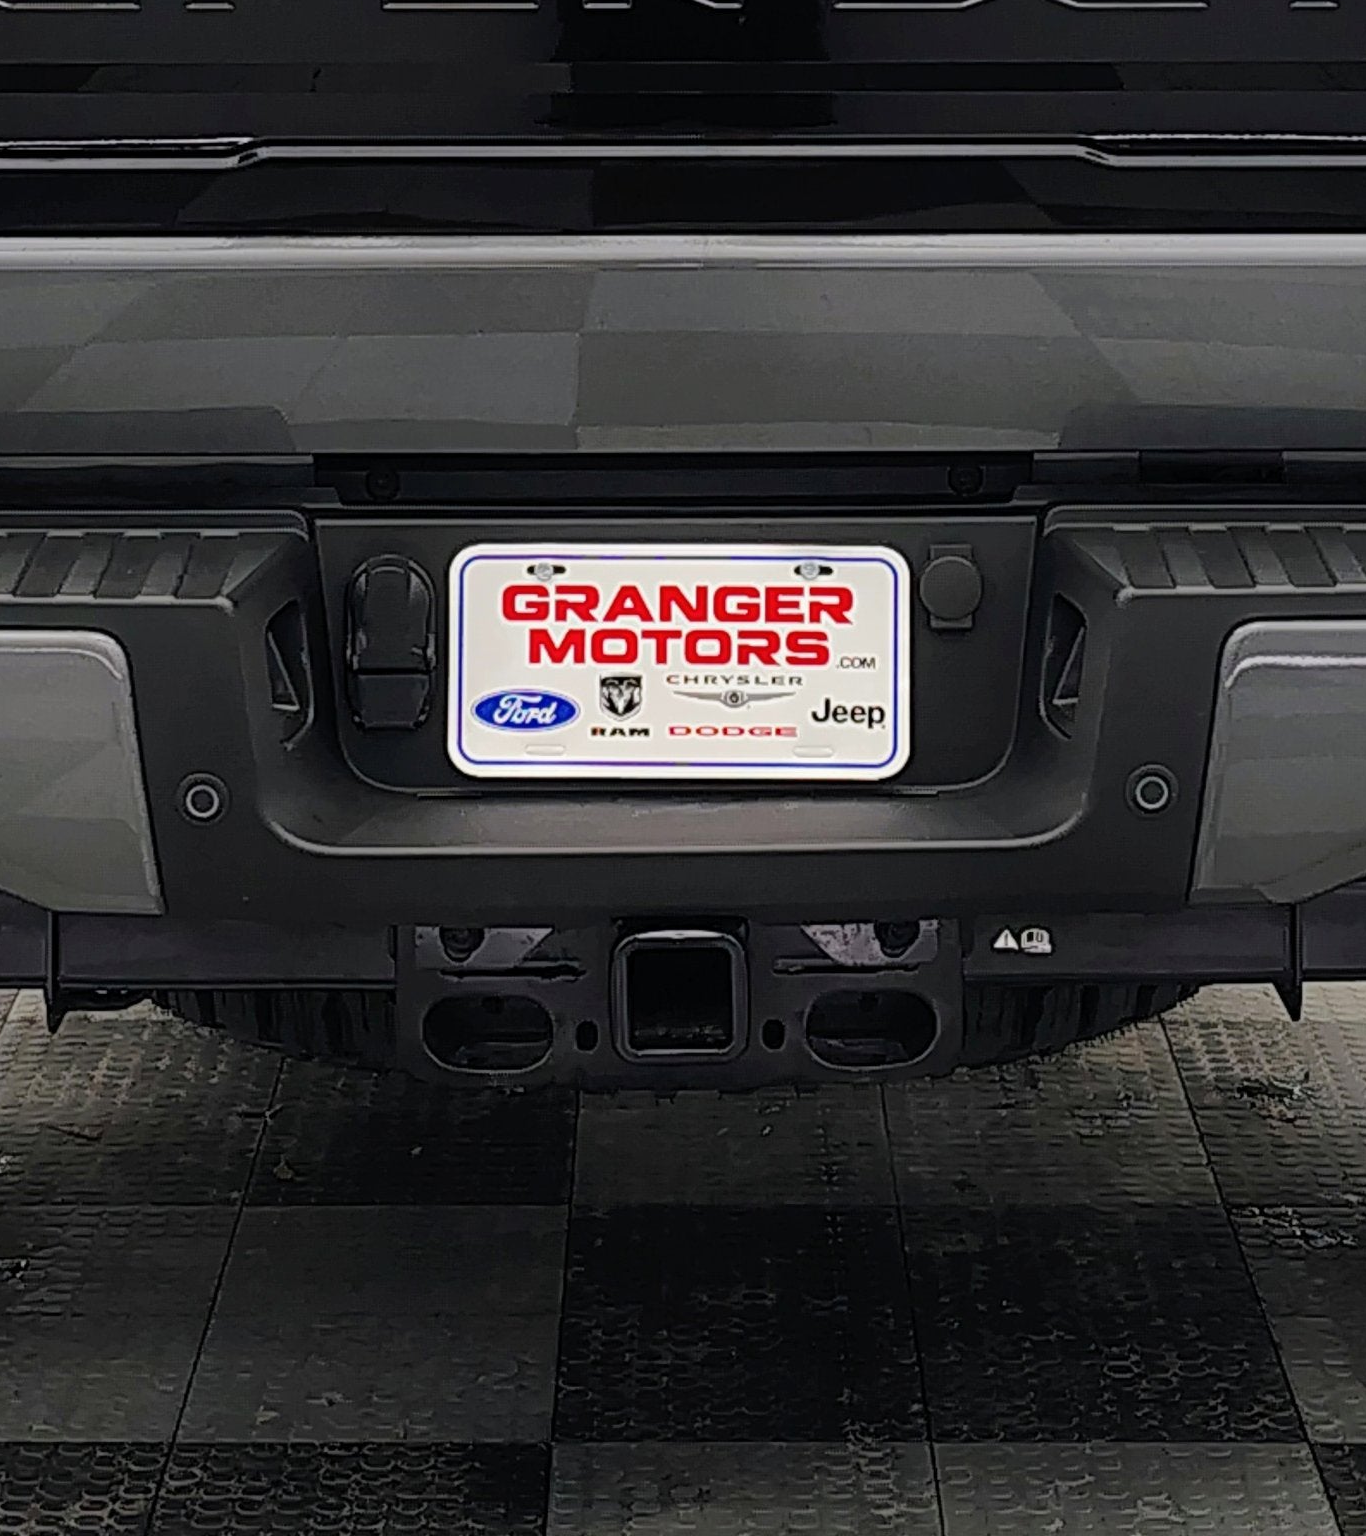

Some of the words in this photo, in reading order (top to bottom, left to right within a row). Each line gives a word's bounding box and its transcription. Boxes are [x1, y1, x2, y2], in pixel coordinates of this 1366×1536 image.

[501, 584, 855, 624] GRANGER
[528, 630, 831, 665] MOTORS
[666, 674, 804, 686] CHRYSLER
[492, 694, 558, 725] Ford
[811, 698, 886, 729] Jeep
[591, 726, 651, 737] RAM
[668, 726, 798, 738] DODGE
